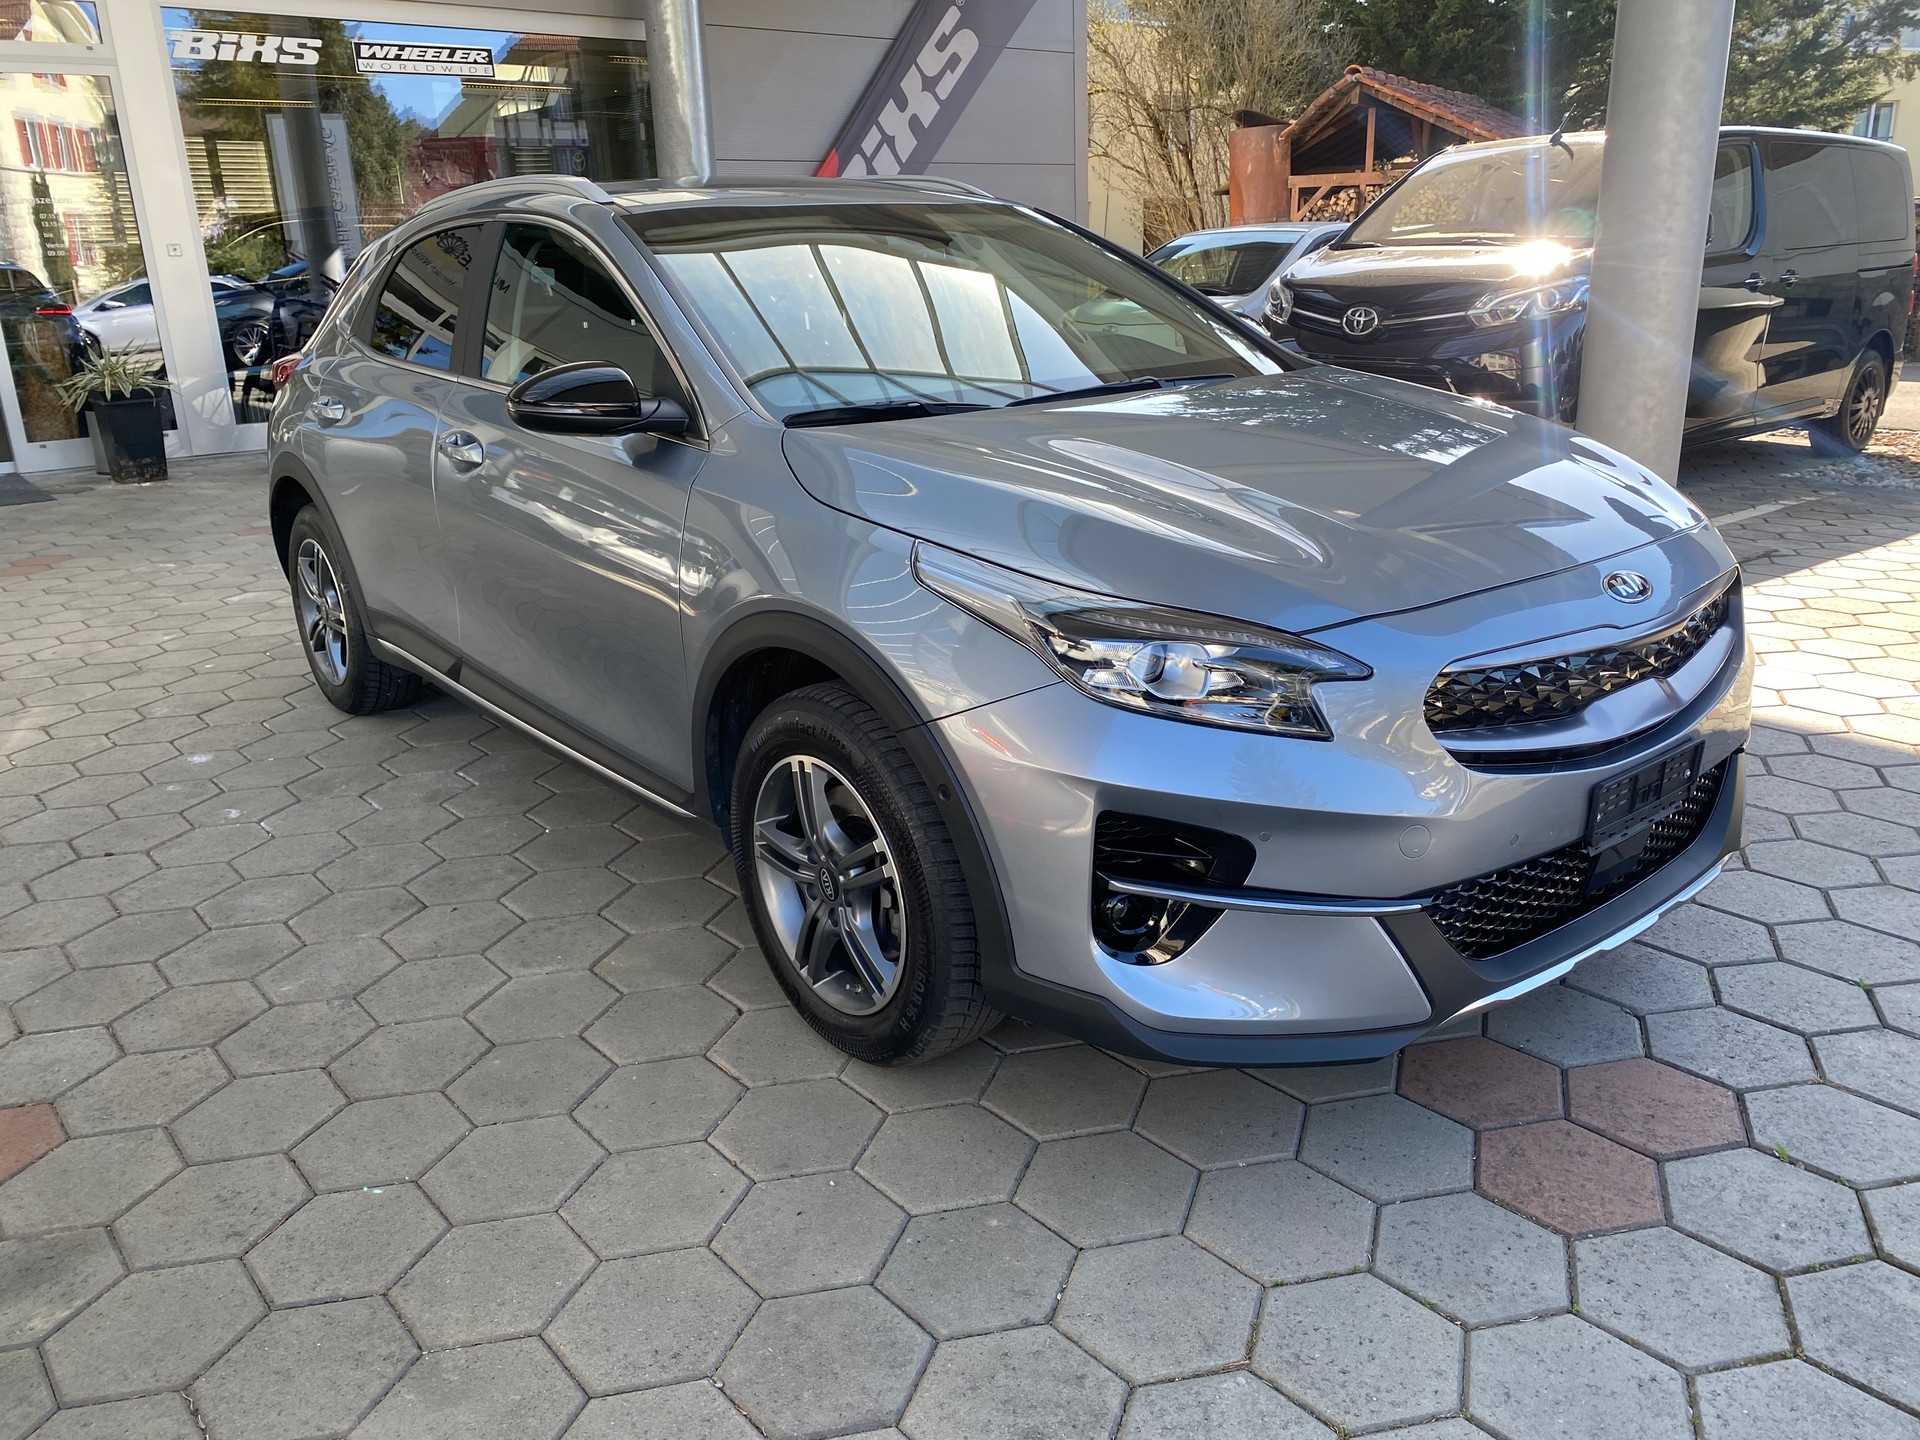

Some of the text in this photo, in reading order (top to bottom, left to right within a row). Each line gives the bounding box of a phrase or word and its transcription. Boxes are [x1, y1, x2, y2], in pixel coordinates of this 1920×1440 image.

[360, 44, 490, 63] WHEELER
[361, 61, 492, 75] WORLDWIDE
[1608, 573, 1651, 599] KIA
